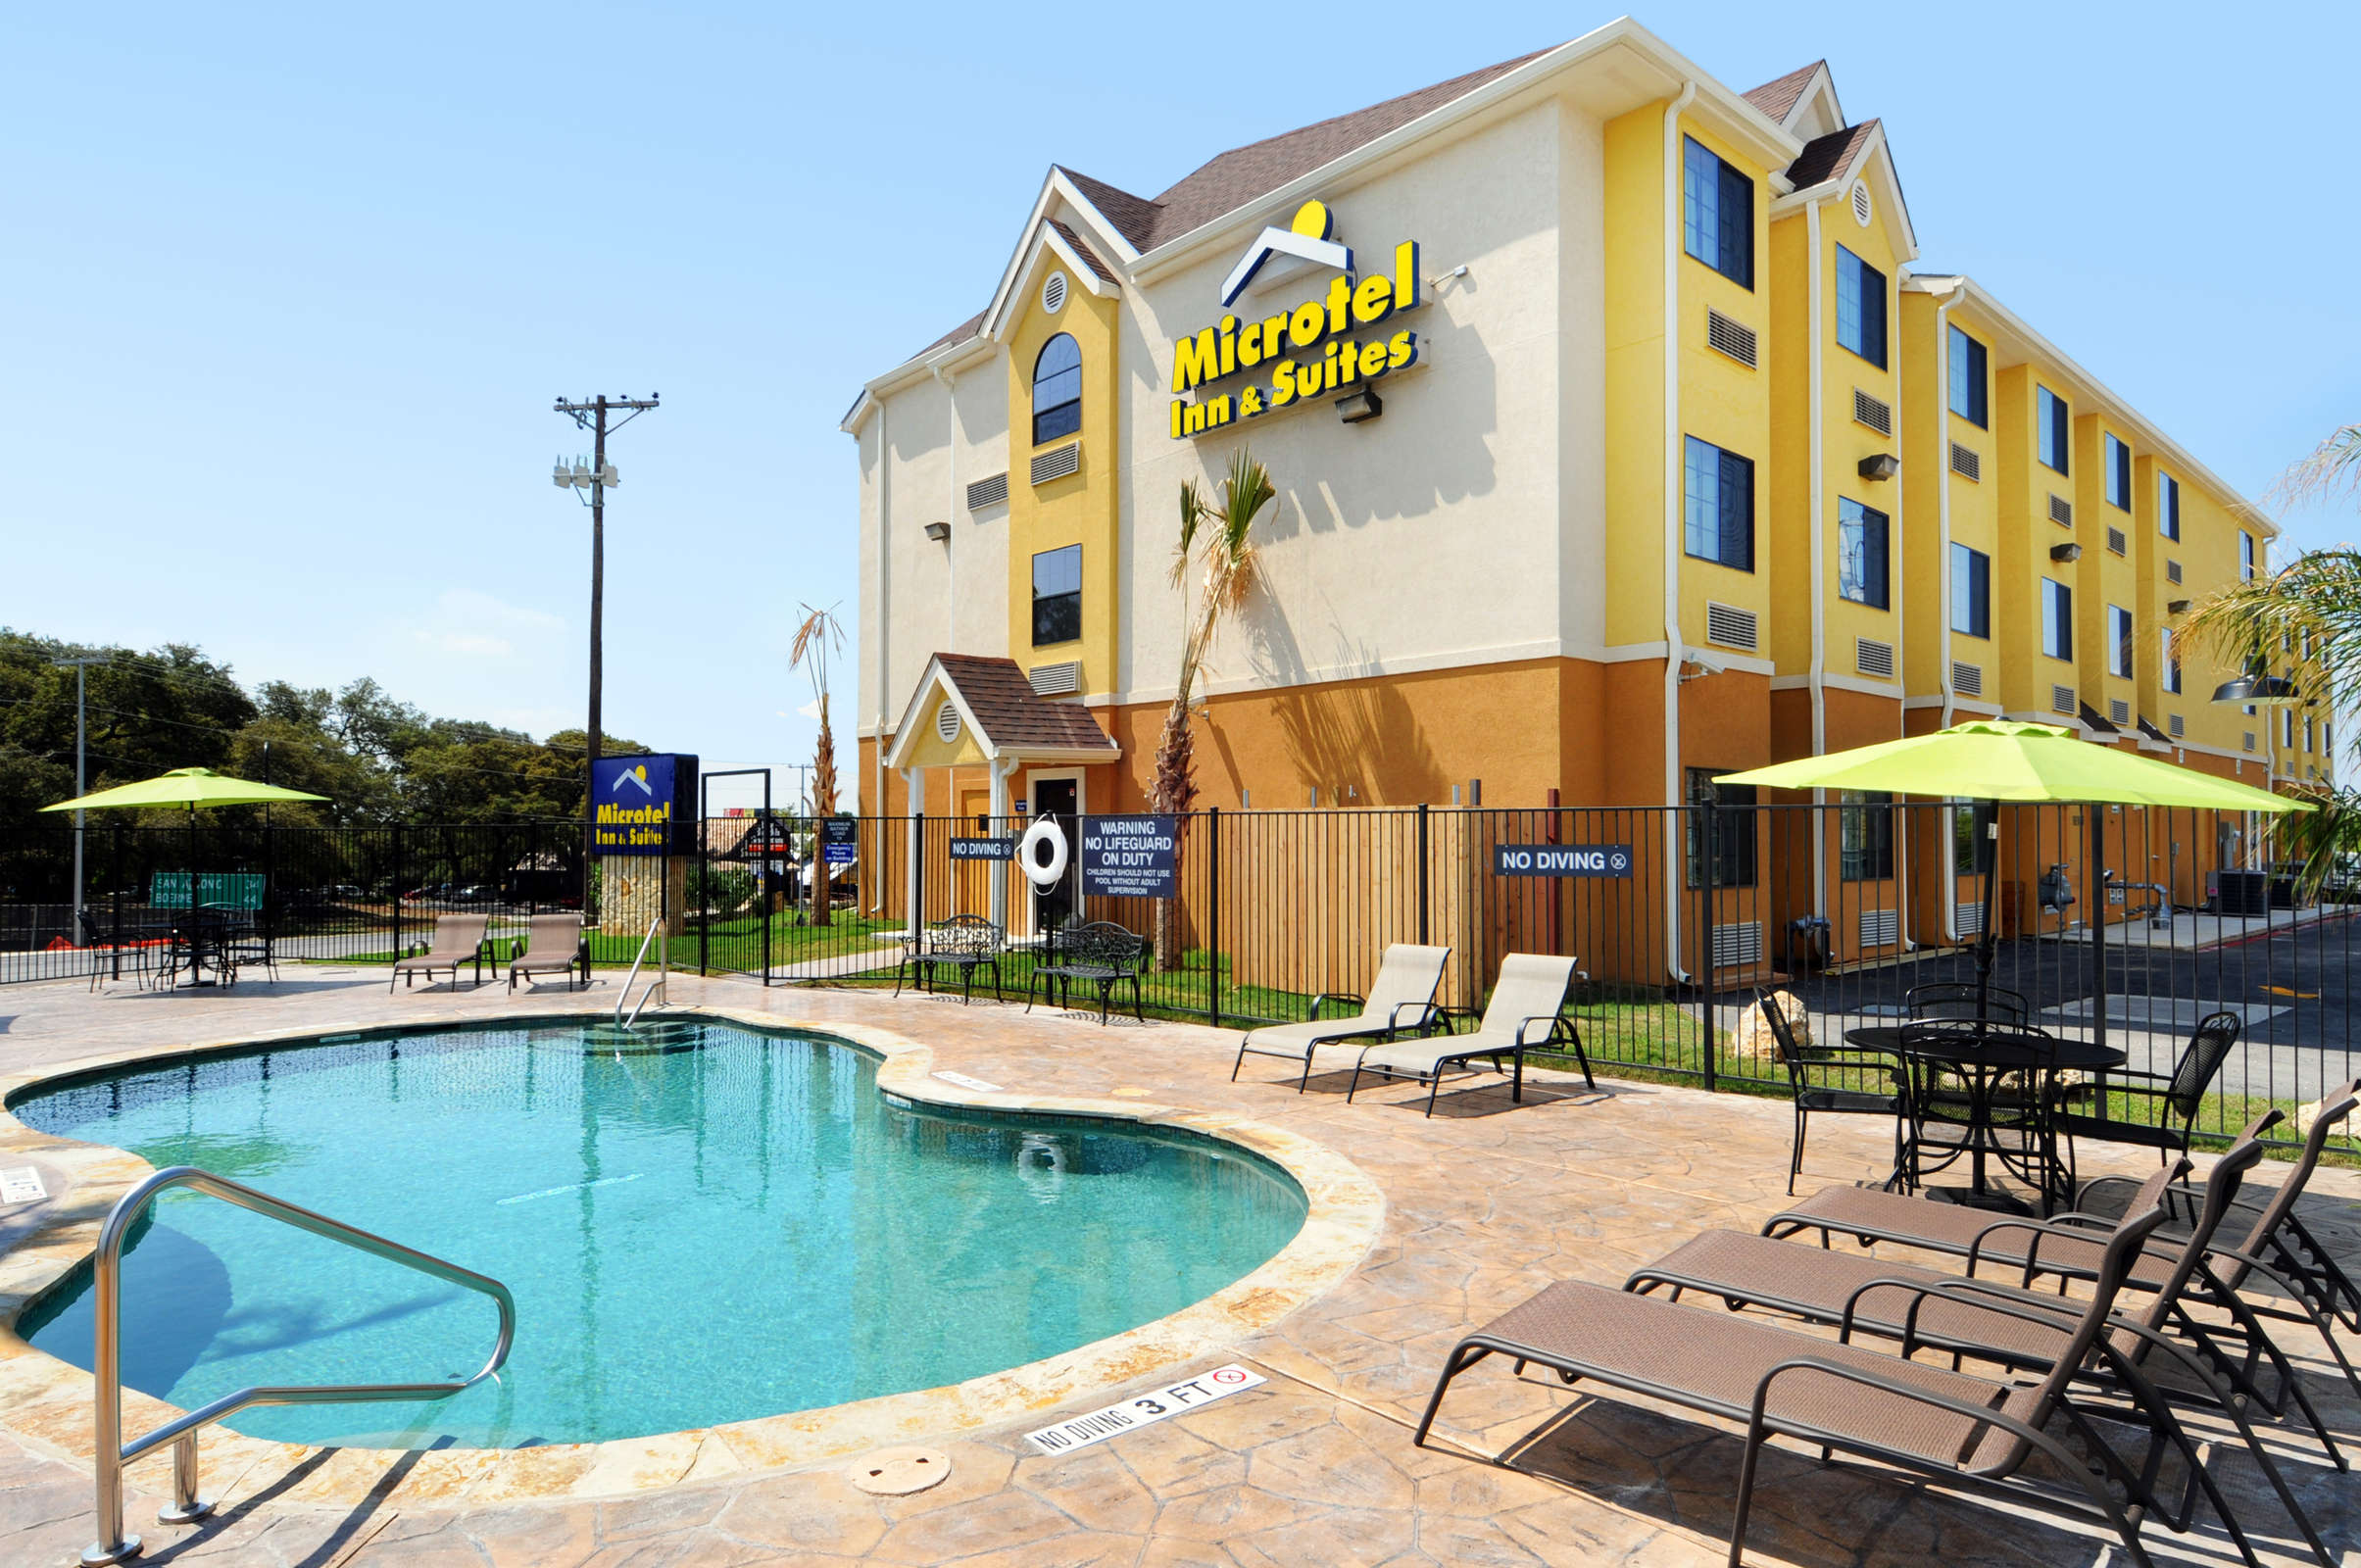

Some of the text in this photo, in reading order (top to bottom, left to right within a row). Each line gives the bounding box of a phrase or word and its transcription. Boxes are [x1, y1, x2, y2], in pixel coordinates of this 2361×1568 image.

[1171, 239, 1419, 394] Microtel
[1170, 330, 1418, 439] Inn & Suites
[597, 802, 669, 825] Microtel
[1100, 821, 1156, 835] WARNING
[596, 828, 616, 845] Inn
[629, 826, 669, 845] Suite
[953, 842, 1001, 856] NO DIVING
[1085, 837, 1172, 851] NO LIFEGUARD
[1102, 852, 1154, 866] ON DUTY
[1502, 852, 1605, 870] NO DIVING
[1117, 868, 1142, 877] SHOULD
[157, 878, 177, 889] SAN
[1107, 886, 1148, 895] SUPERVISION
[1034, 1381, 1212, 1450] NO DIVING 3 FT
